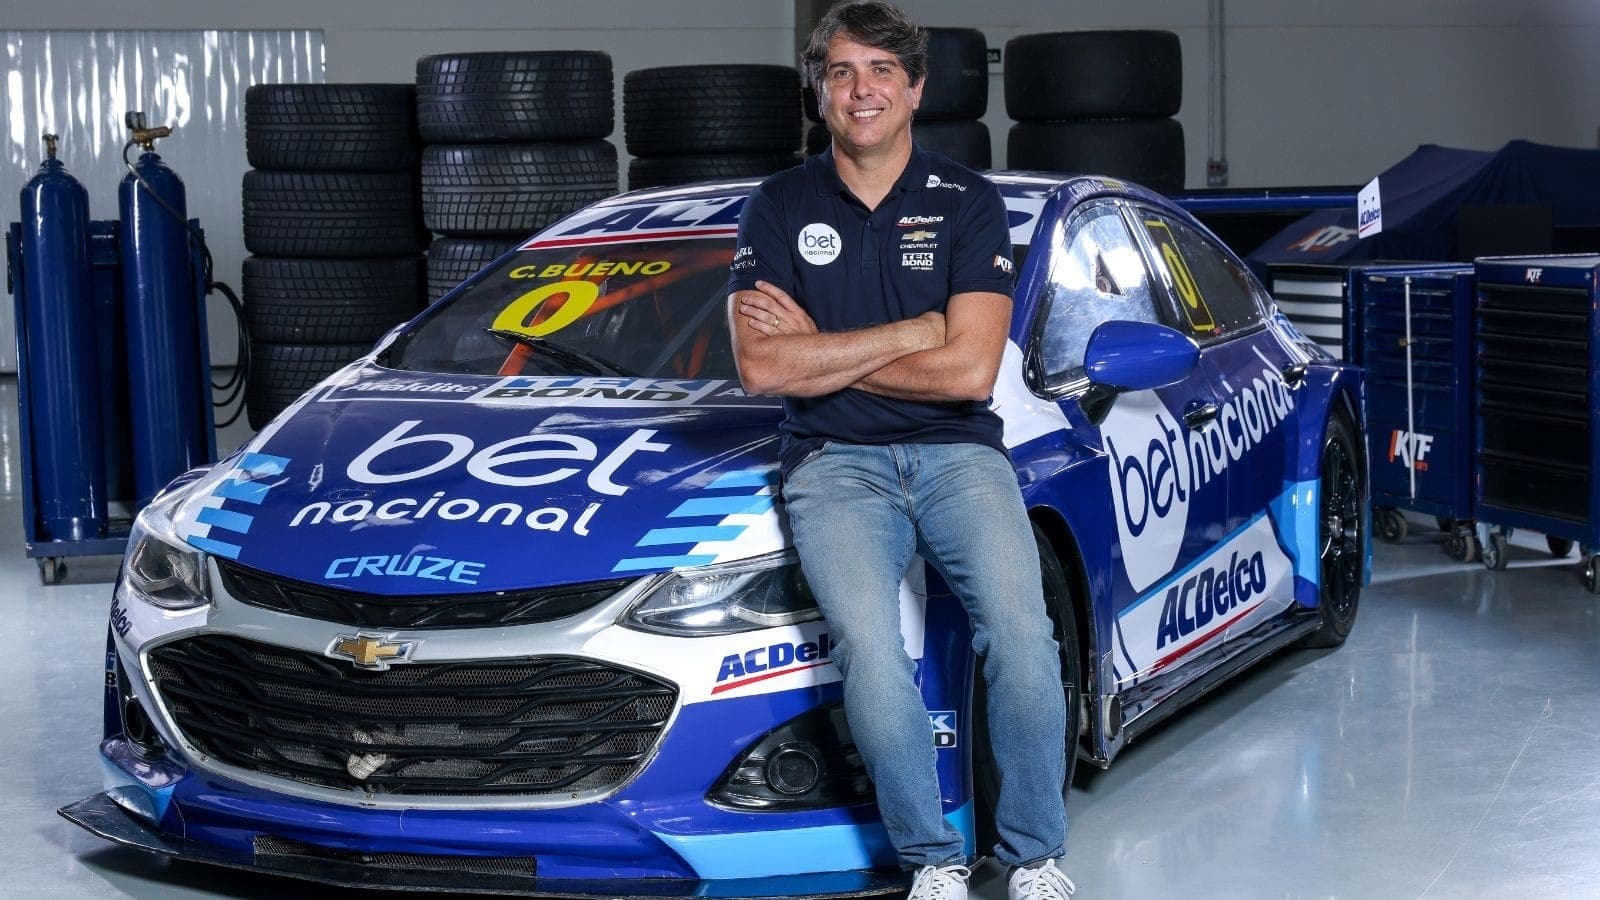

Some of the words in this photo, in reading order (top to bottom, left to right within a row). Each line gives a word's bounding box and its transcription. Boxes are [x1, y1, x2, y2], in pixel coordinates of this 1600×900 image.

[1360, 207, 1380, 227] ACDelco
[804, 230, 836, 249] bet
[509, 260, 671, 280] C.BUENO
[902, 259, 933, 267] BOND
[492, 280, 600, 338] 0
[483, 387, 690, 401] BOND
[1105, 414, 1187, 537] bet
[1189, 345, 1295, 491] nacional
[347, 420, 672, 496] bet
[289, 491, 602, 537] nacional
[324, 555, 486, 585] CRUZE
[1156, 550, 1267, 650] ACDelco
